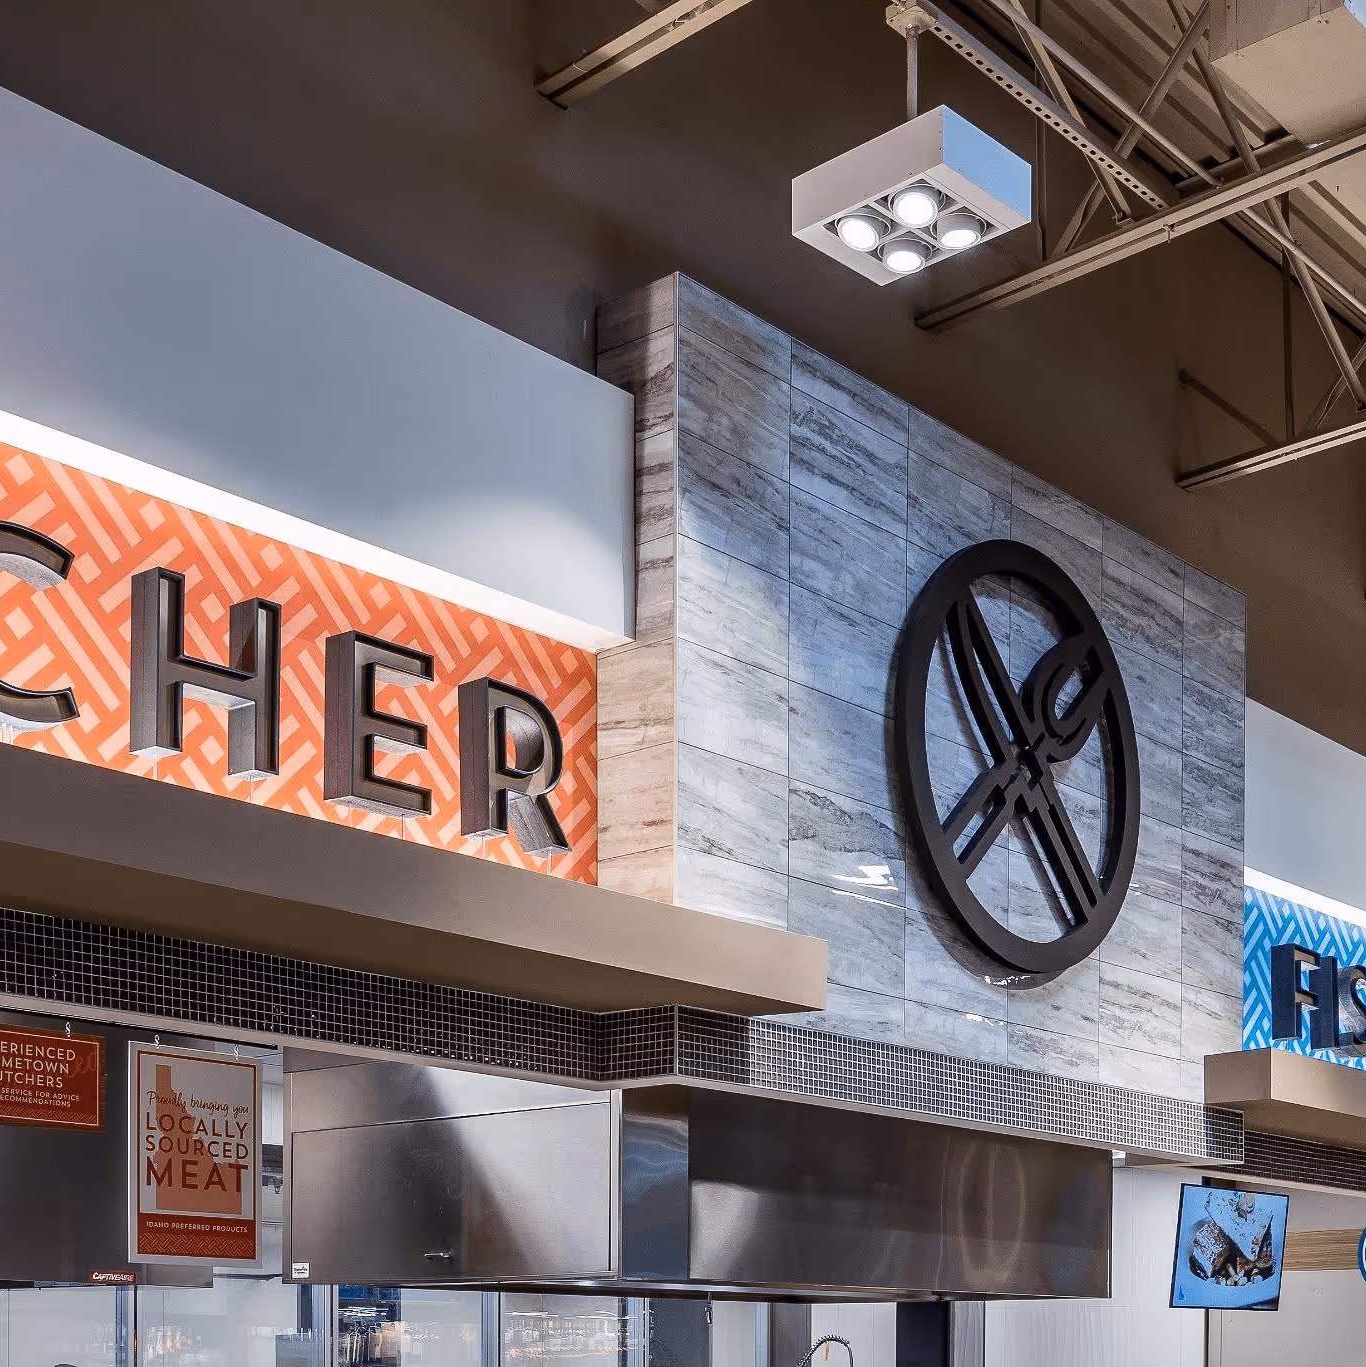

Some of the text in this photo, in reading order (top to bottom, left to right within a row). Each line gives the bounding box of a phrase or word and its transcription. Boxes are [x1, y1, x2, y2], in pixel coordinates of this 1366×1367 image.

[1, 1087, 33, 1097] SERVICE
[35, 1090, 51, 1099] FOR
[52, 1092, 80, 1102] ADVICE
[146, 1090, 249, 1119] Proudly bringing you
[146, 1111, 249, 1139] LOCALLY
[145, 1135, 249, 1160] SOURCED
[145, 1156, 249, 1193] MEAT
[146, 1221, 248, 1233] IDAHO PREFERRED PRODUCTS
